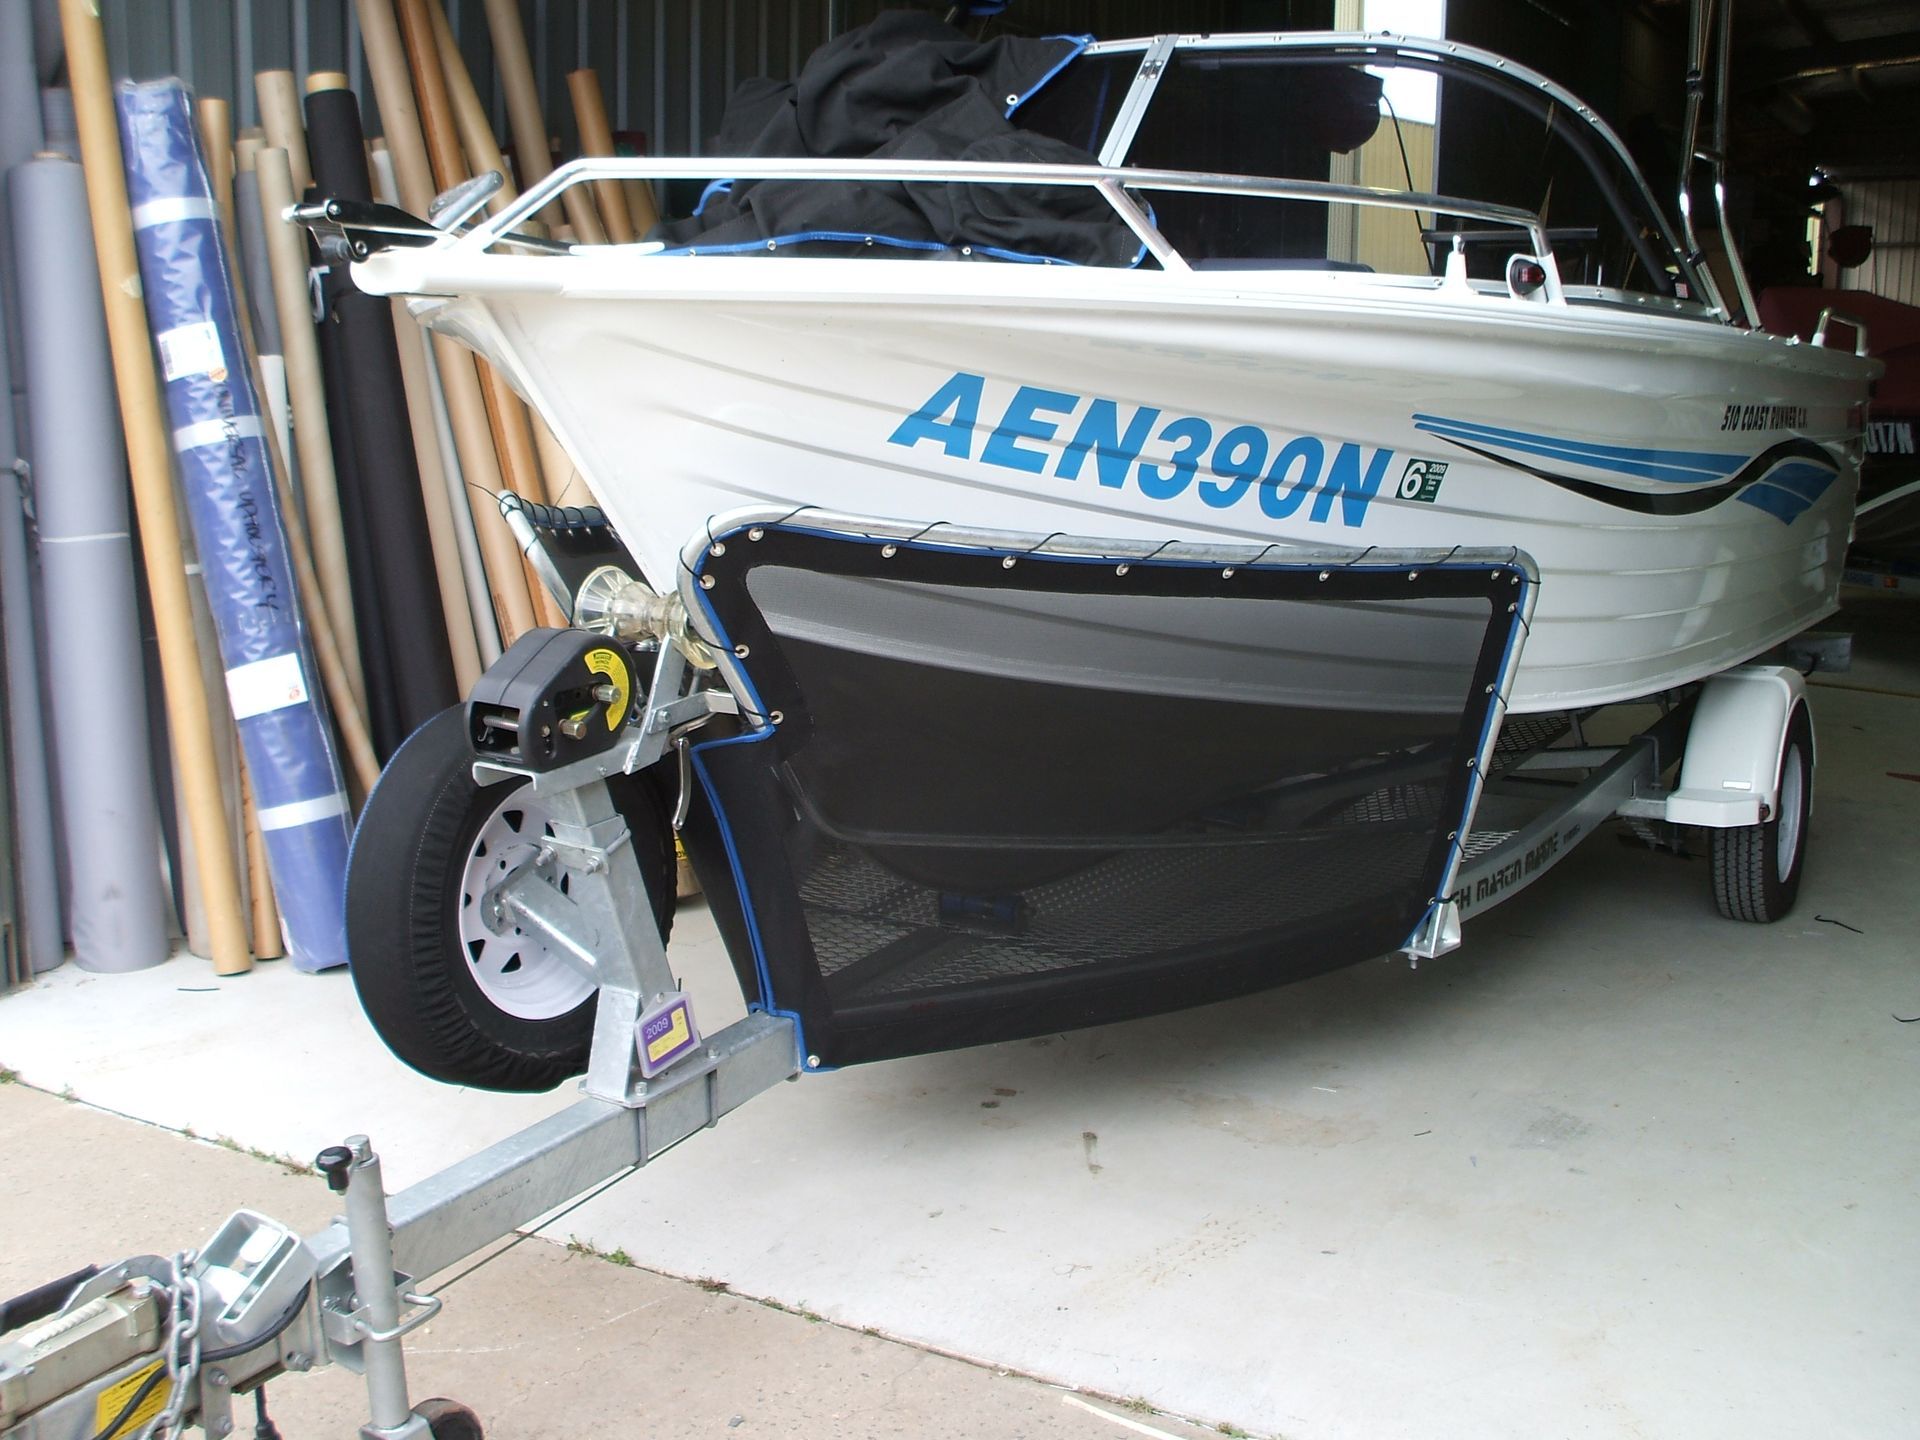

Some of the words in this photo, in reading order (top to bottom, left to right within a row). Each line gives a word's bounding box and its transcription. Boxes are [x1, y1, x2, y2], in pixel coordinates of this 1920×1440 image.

[1721, 405, 1741, 431] 510
[1741, 405, 1770, 431] COAST
[886, 372, 1394, 528] AEN390N
[1401, 461, 1427, 499] 6
[1430, 463, 1446, 474] 2009
[1477, 859, 1522, 902] MARTIN
[646, 1017, 669, 1039] 2009
